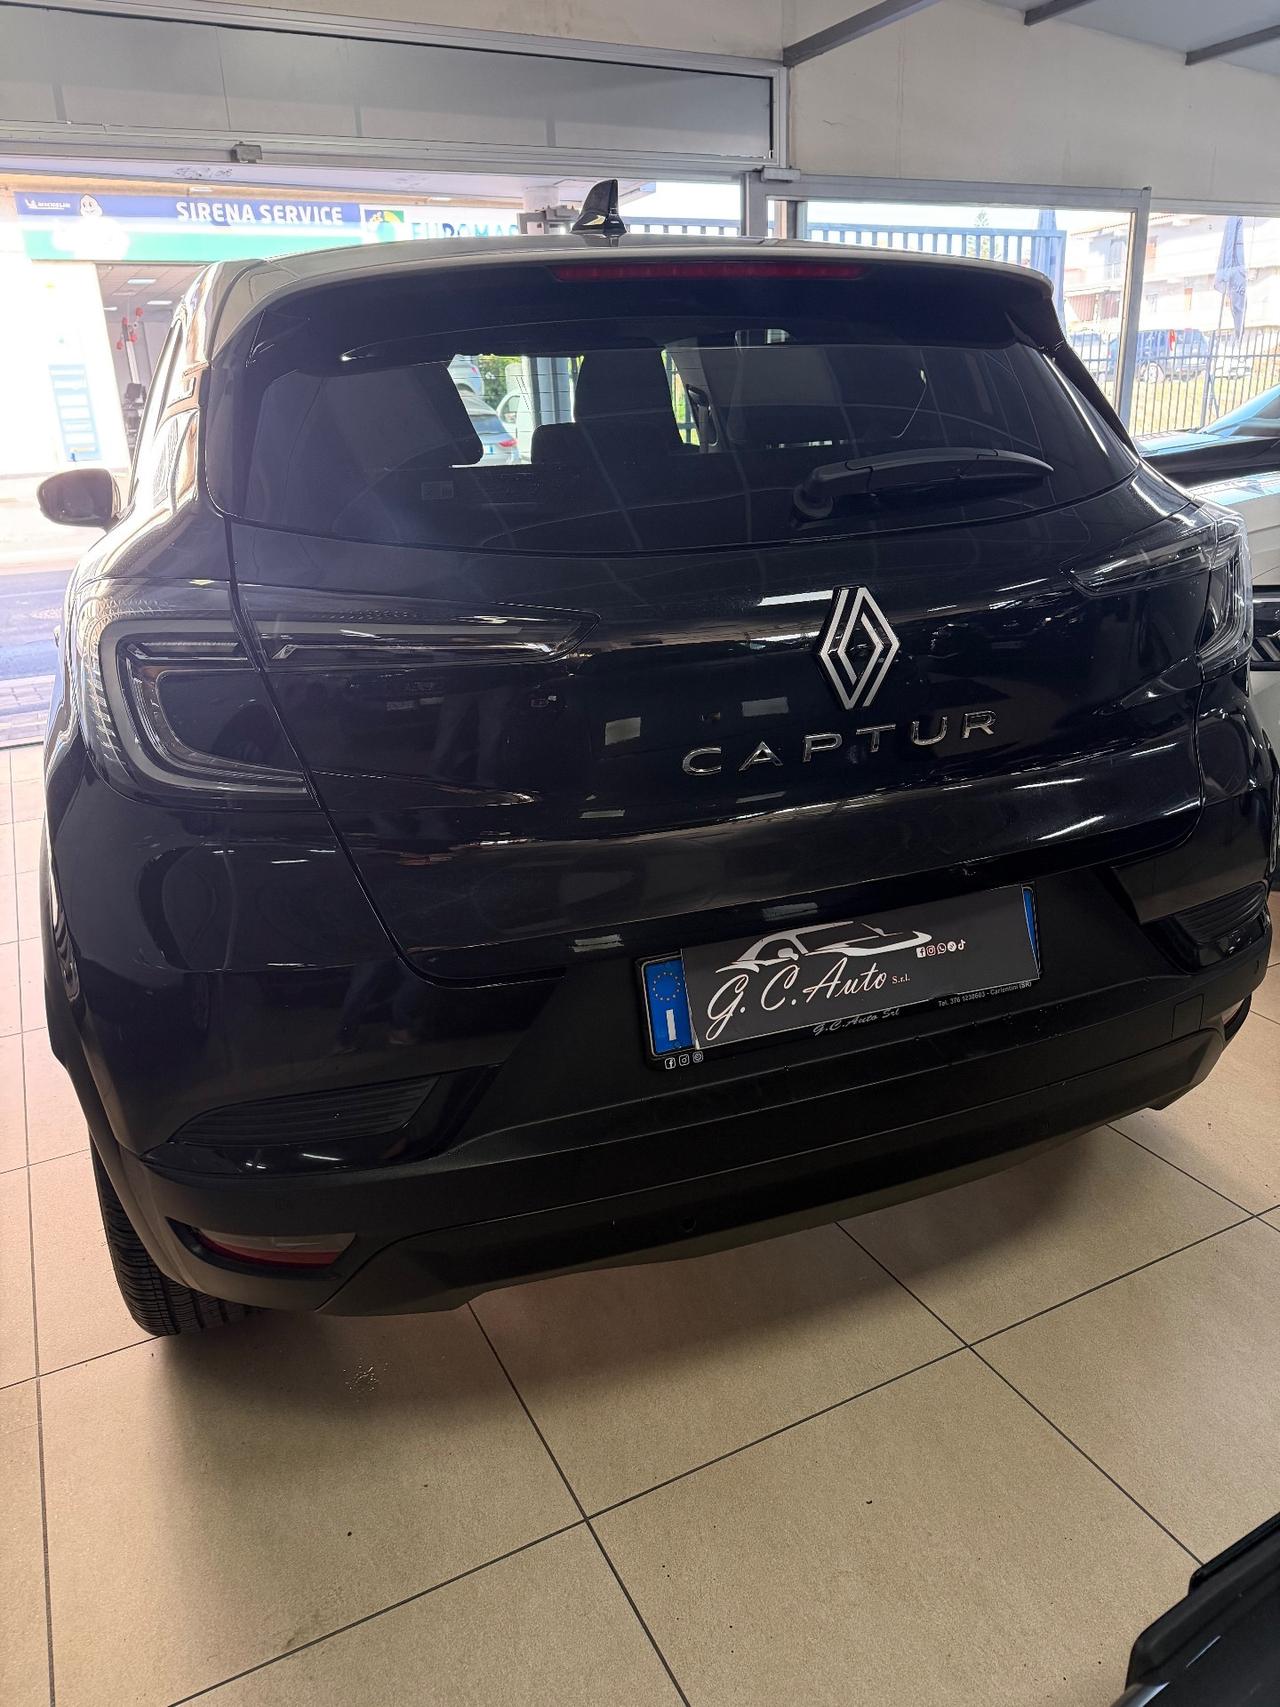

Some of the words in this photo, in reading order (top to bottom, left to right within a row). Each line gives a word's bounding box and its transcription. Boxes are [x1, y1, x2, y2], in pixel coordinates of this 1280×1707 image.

[175, 201, 256, 224] SIRENA
[259, 204, 344, 226] SERVICE
[682, 710, 997, 776] CAPTUR
[760, 964, 800, 1011] C.
[803, 957, 887, 1003] Auto
[891, 974, 911, 985] S.r.l.
